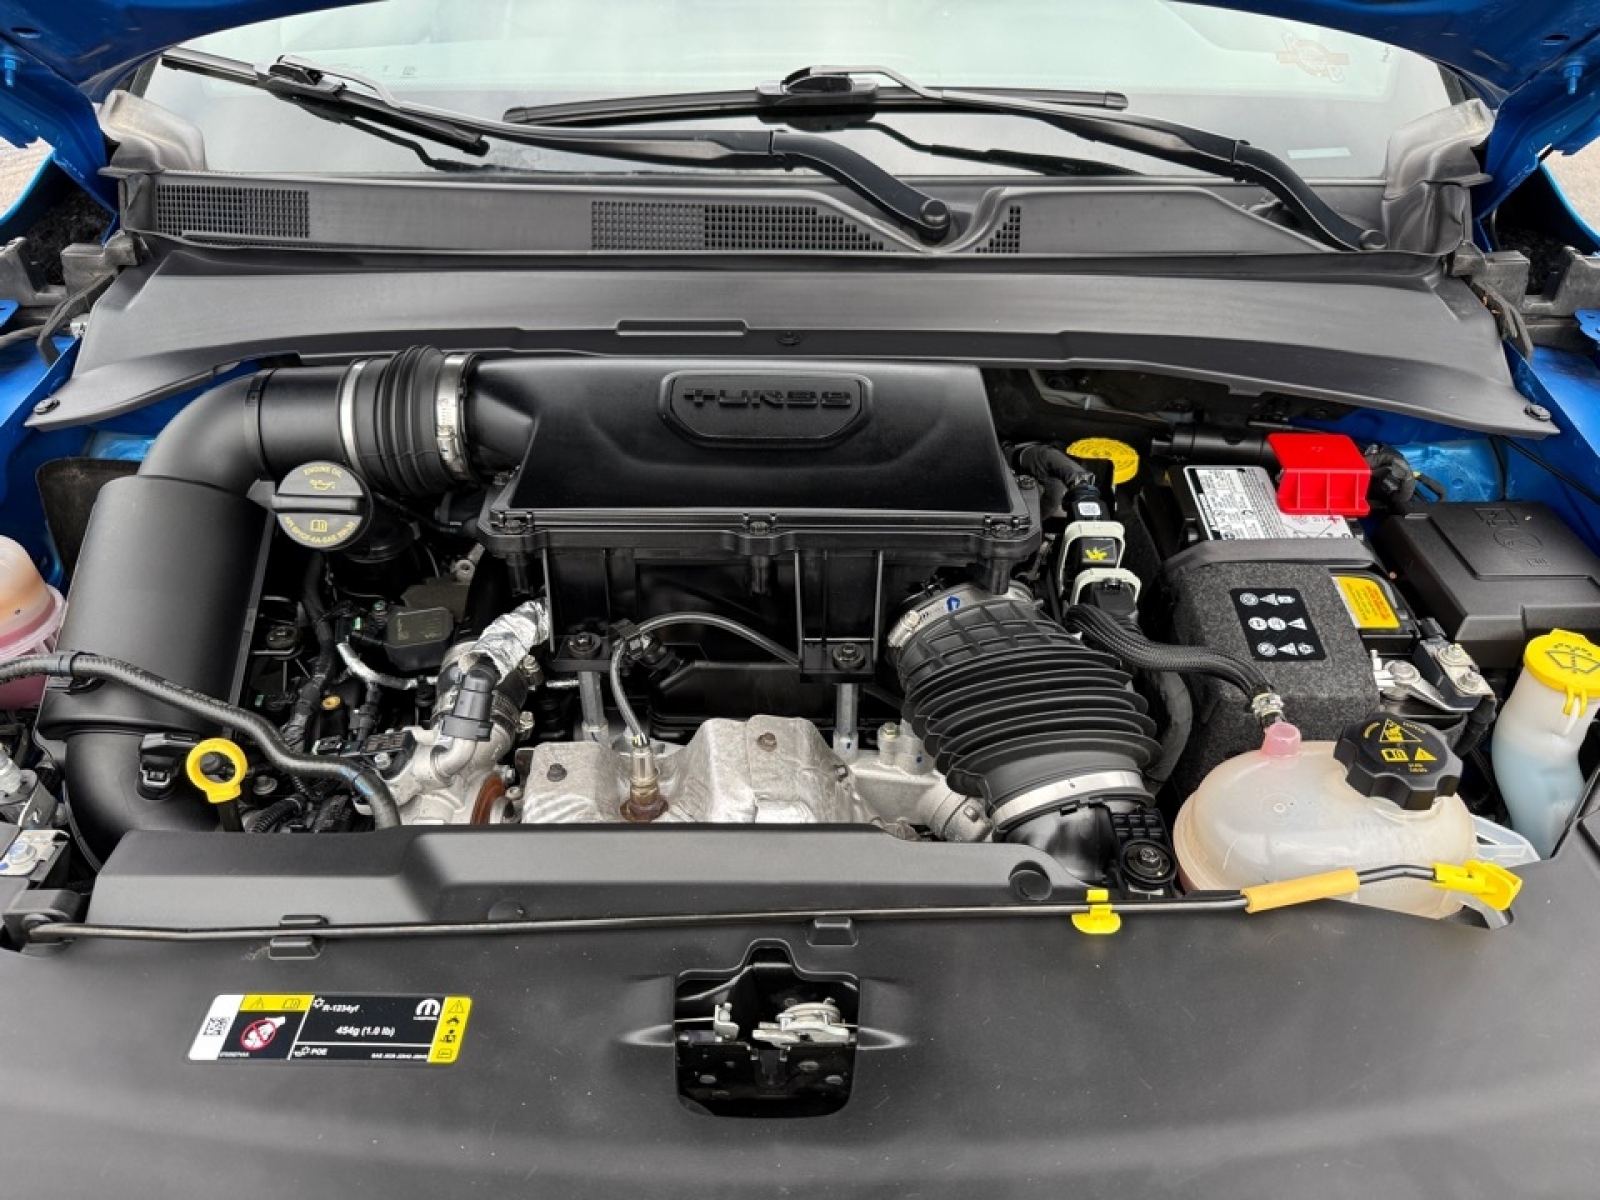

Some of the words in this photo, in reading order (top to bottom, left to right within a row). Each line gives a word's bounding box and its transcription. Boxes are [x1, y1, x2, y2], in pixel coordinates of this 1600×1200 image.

[302, 466, 331, 476] ENGINE
[331, 468, 343, 479] OIL
[321, 1004, 360, 1014] R-1234yf
[335, 1025, 360, 1037] 454g
[310, 1048, 328, 1056] POE
